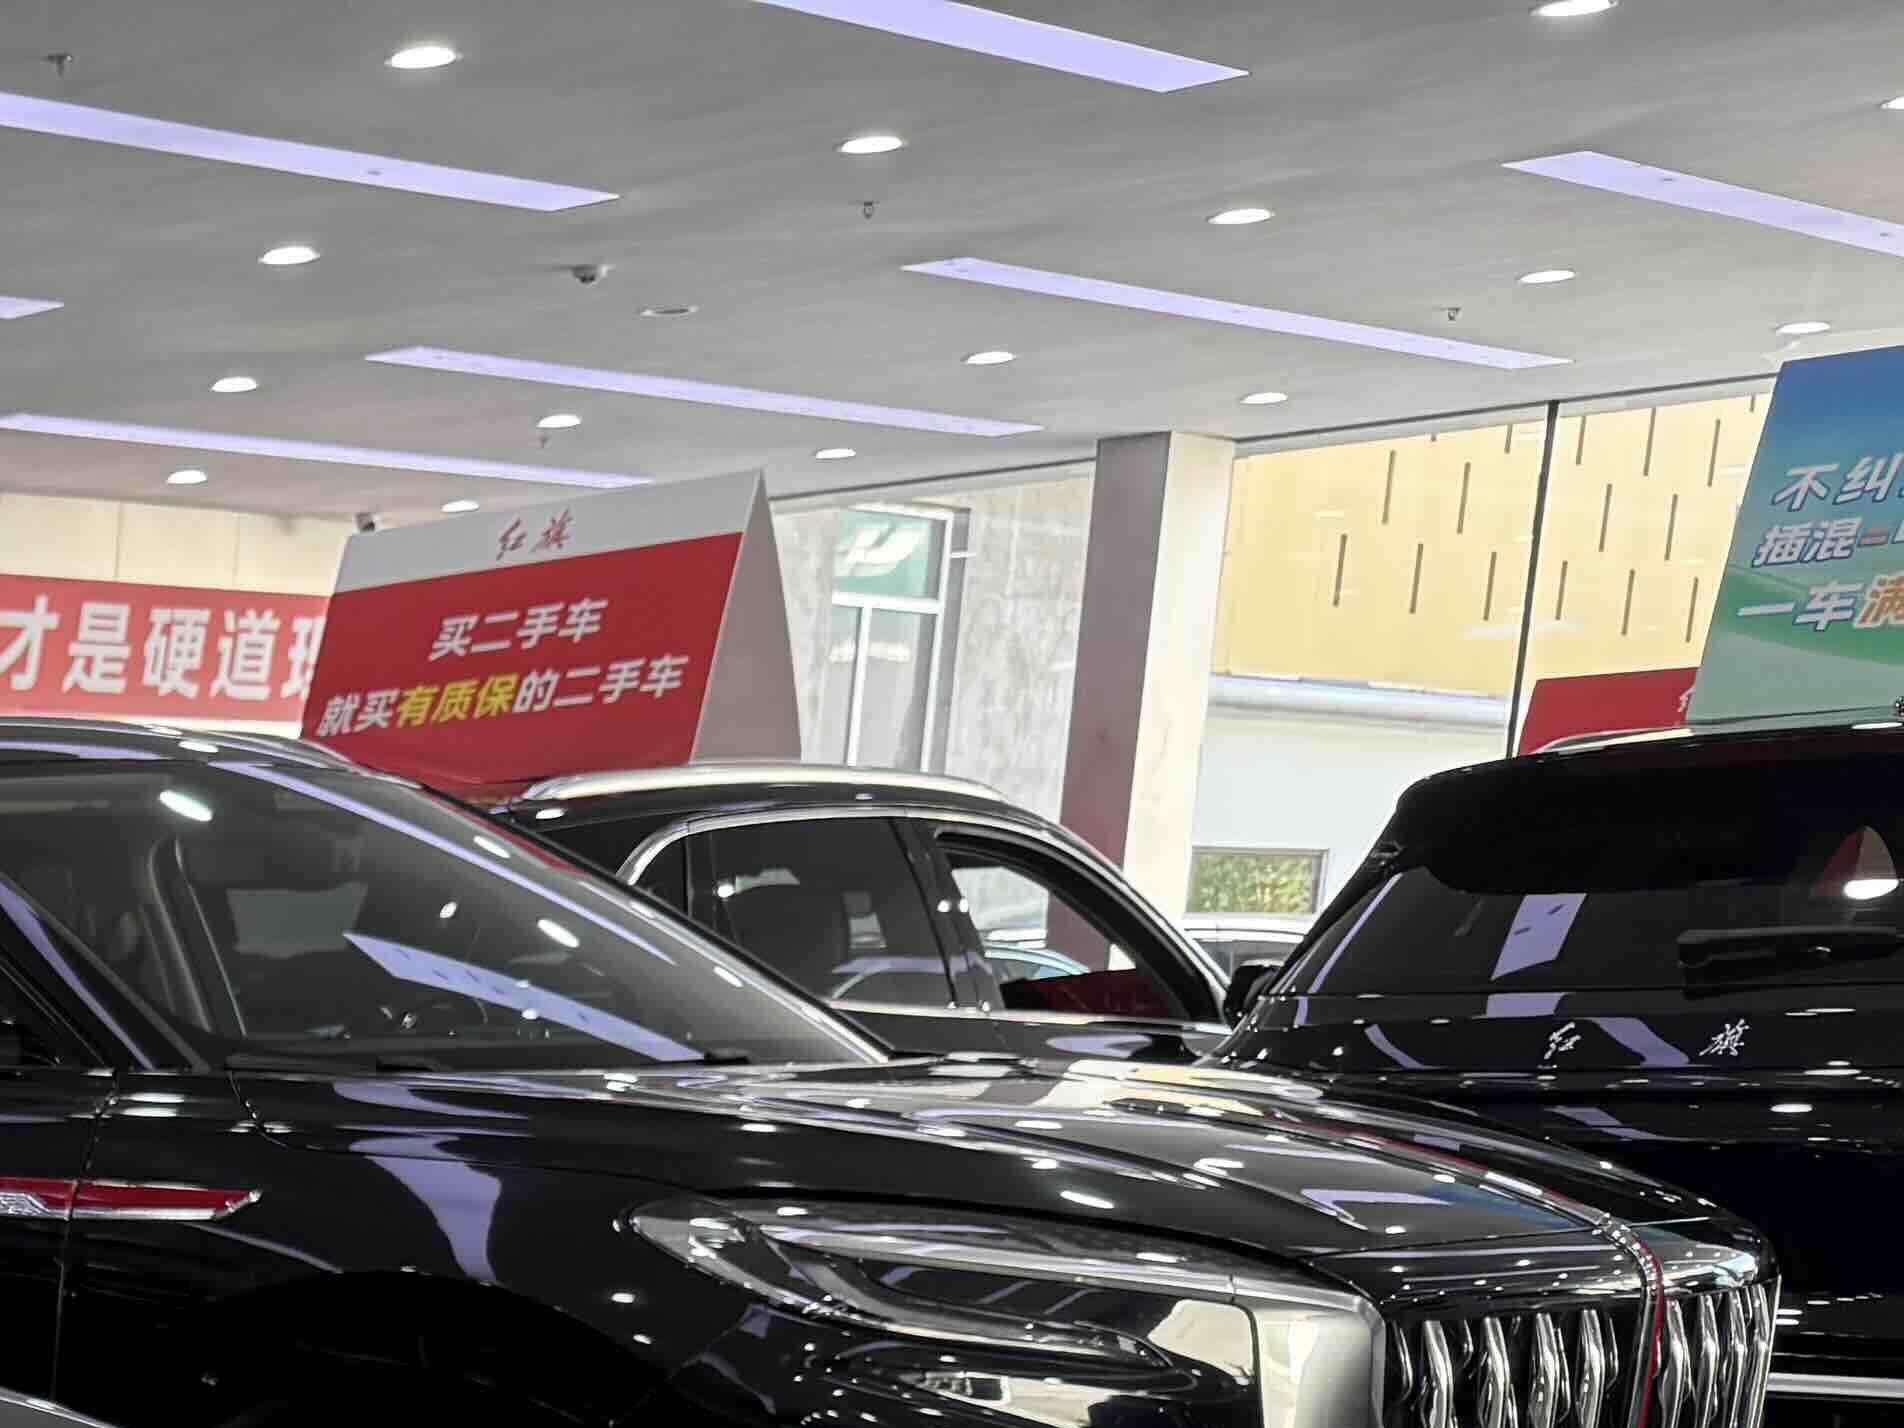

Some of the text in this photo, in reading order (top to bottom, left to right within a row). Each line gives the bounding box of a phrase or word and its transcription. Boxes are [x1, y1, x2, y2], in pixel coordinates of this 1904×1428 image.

[1771, 452, 1904, 512] 不纠
[496, 508, 577, 561] 红旗
[1751, 516, 1904, 569] 插混=
[428, 597, 609, 662] 买二手车
[316, 653, 689, 738] 就买有质保的二手车
[1543, 1018, 1750, 1060] 红旗
